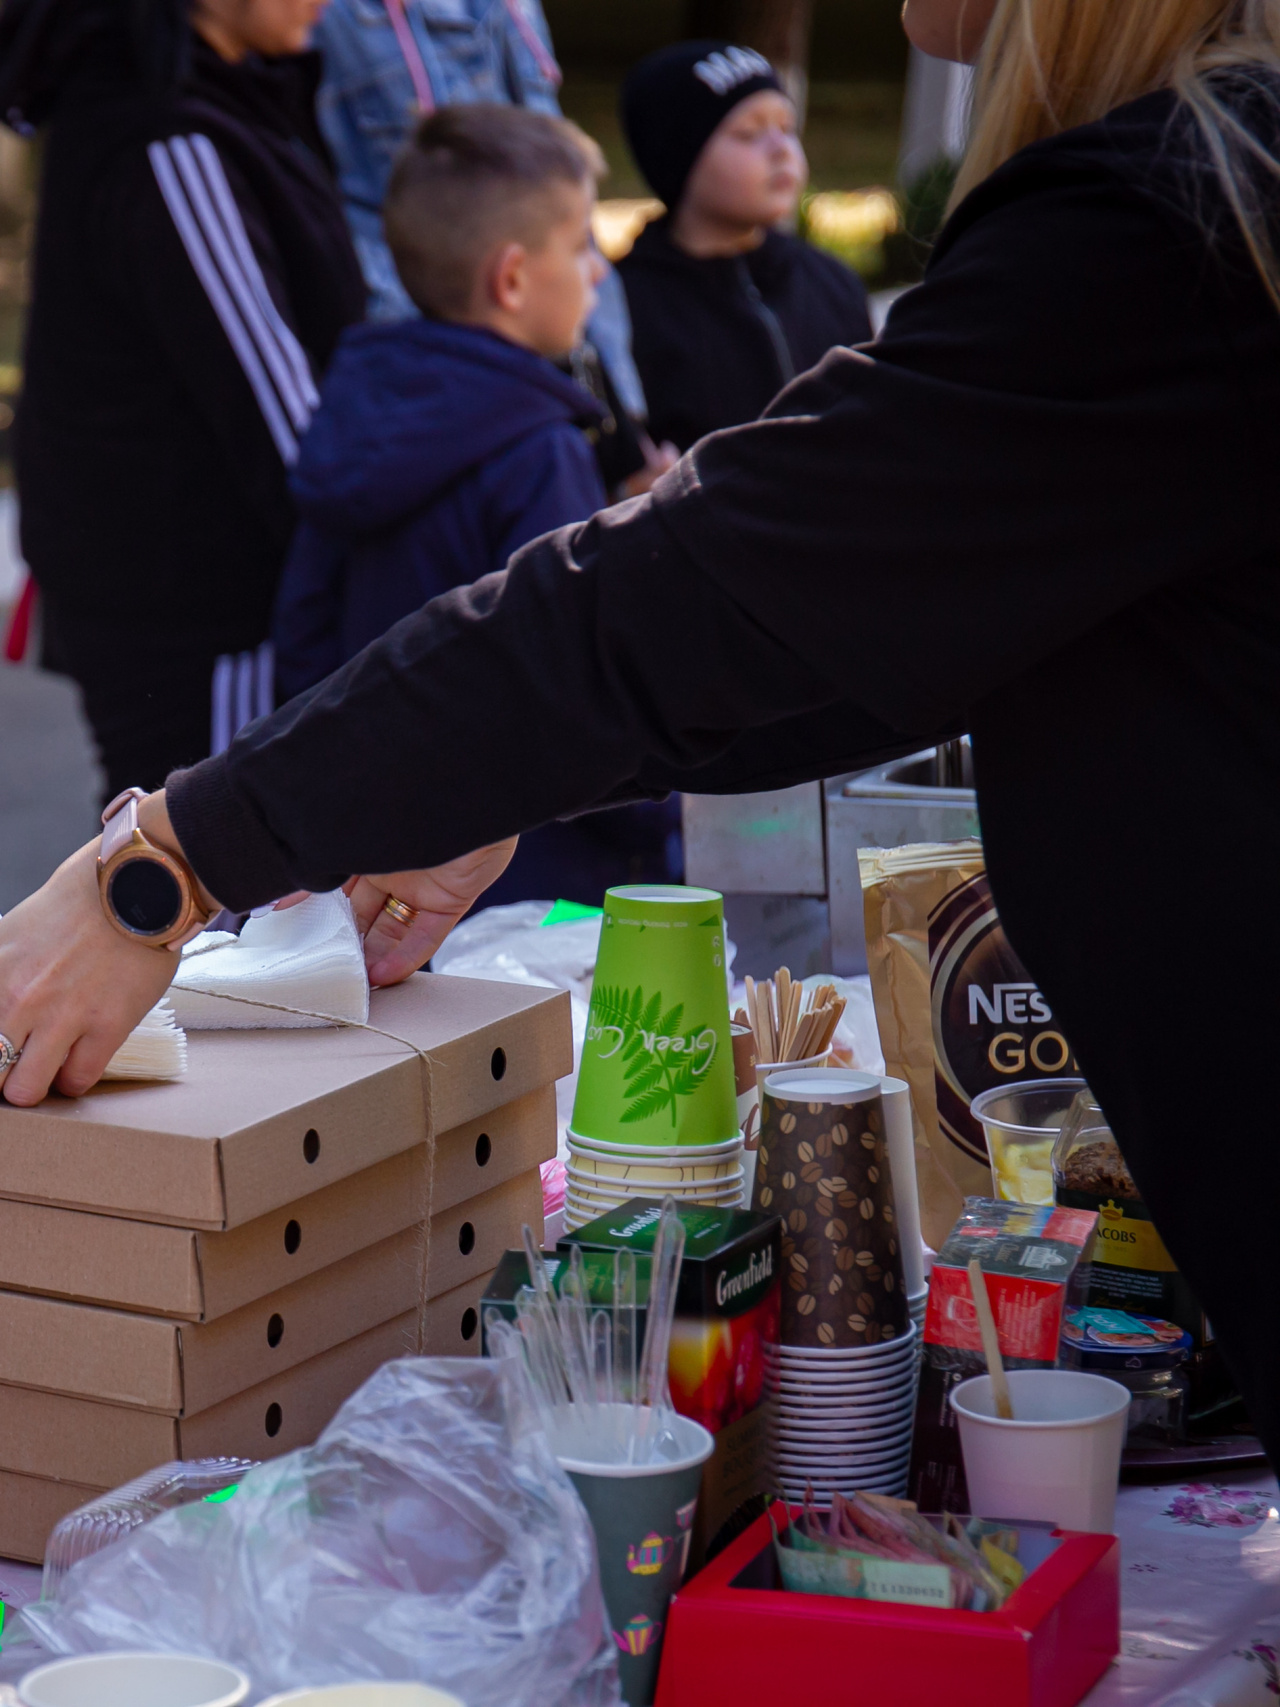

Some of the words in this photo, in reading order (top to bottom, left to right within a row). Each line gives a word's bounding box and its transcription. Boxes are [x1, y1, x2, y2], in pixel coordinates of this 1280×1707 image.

[968, 982, 1052, 1025] NES
[644, 1028, 717, 1075] Green
[1097, 1227, 1137, 1244] ACOBS
[716, 1244, 773, 1306] Greenfield
